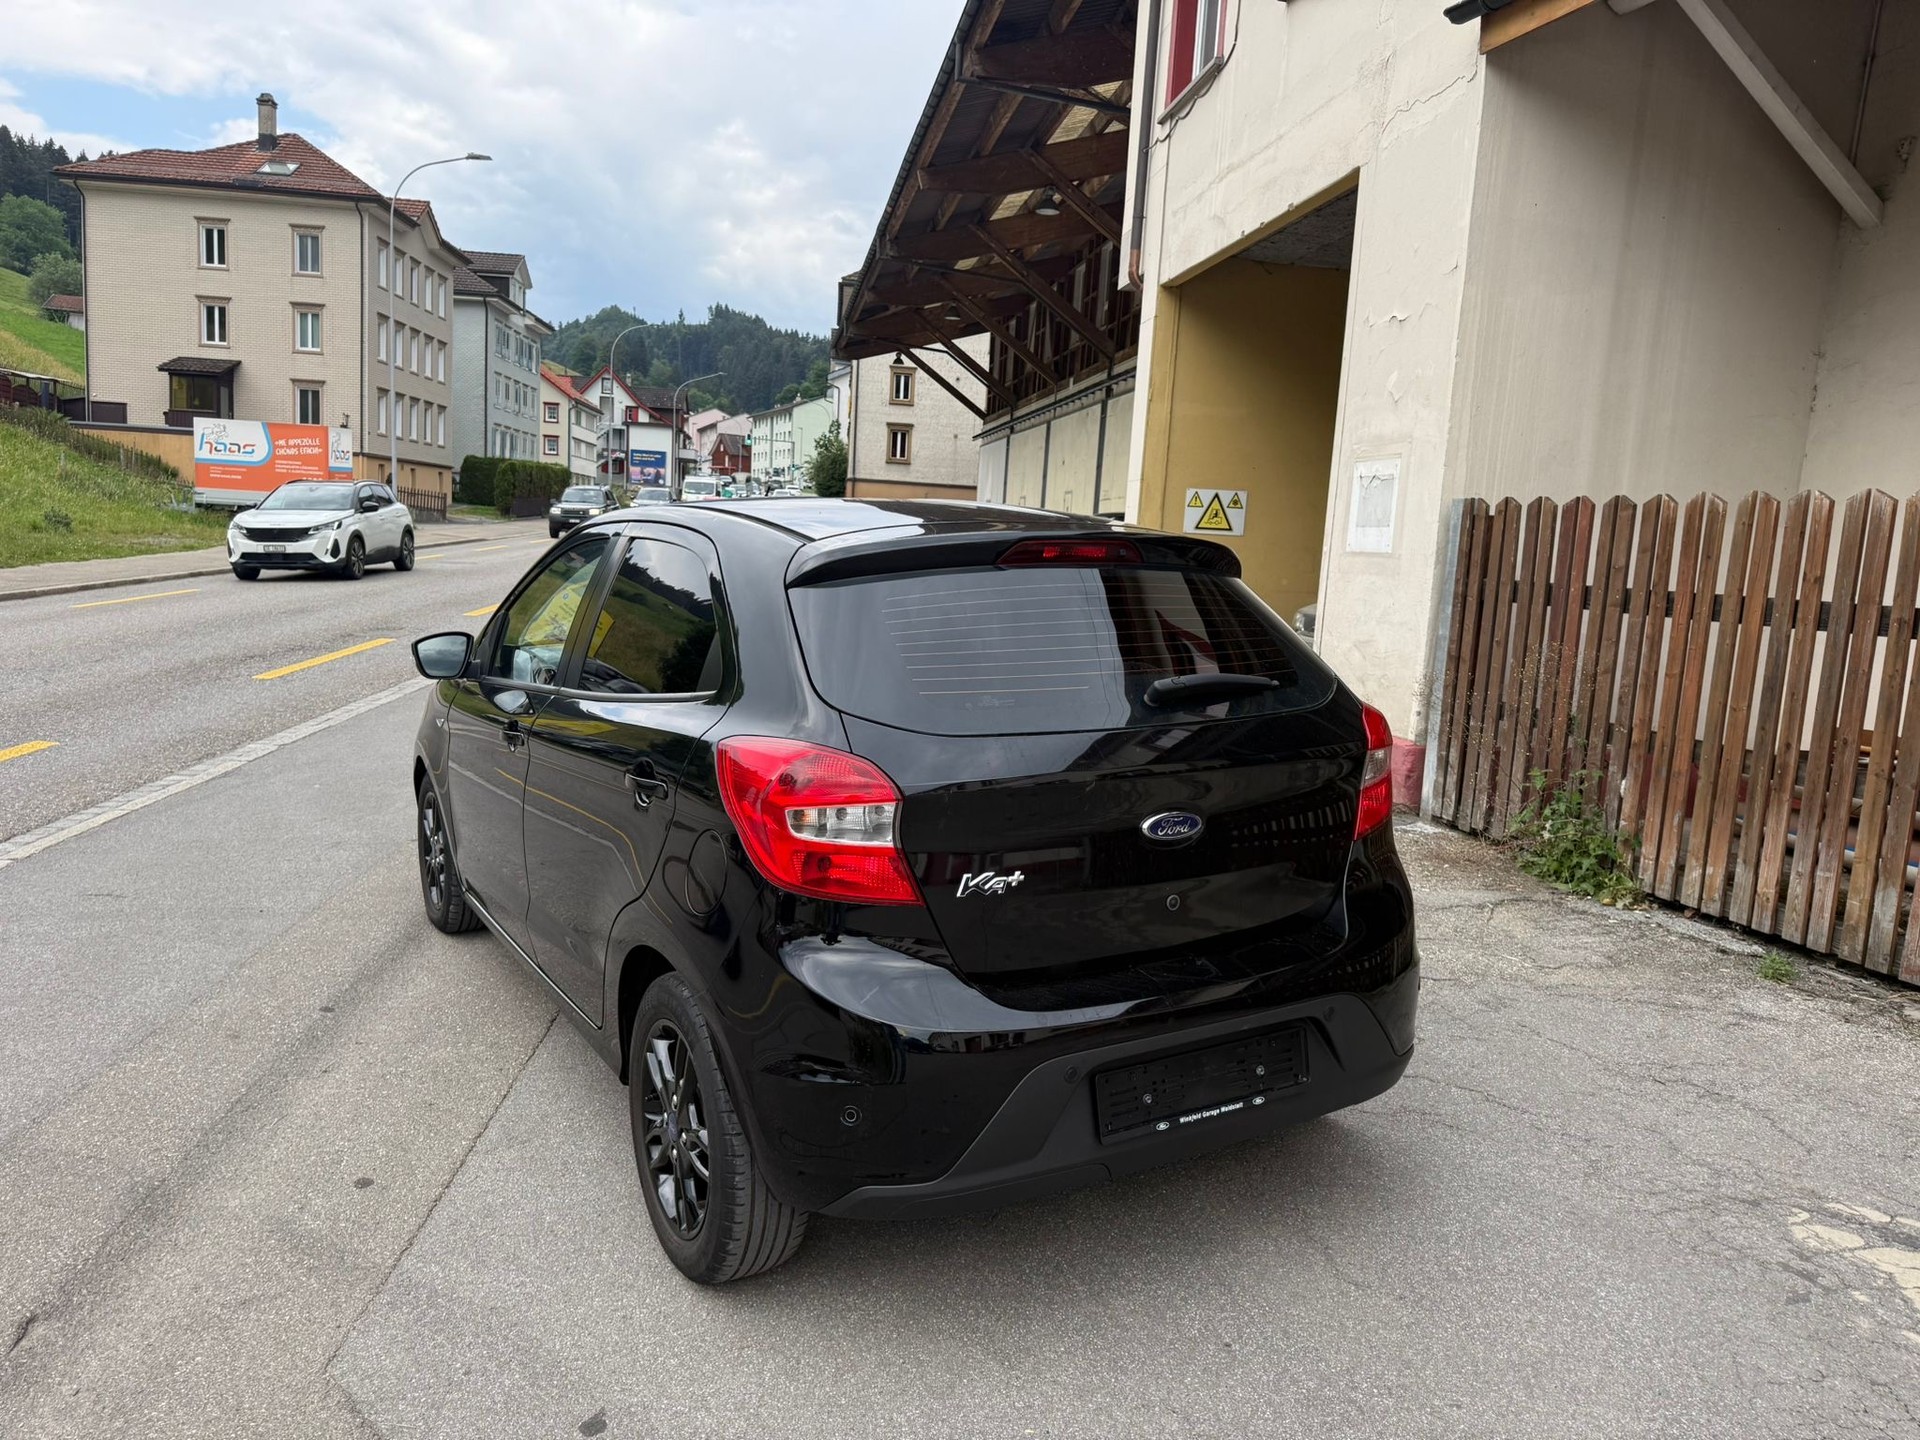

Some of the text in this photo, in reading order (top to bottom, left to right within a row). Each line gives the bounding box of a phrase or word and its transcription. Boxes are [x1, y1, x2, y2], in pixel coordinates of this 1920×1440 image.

[199, 432, 256, 455] haas
[1157, 816, 1191, 836] Ford
[956, 870, 1025, 898] Ka+
[1202, 1108, 1220, 1118] Garage
